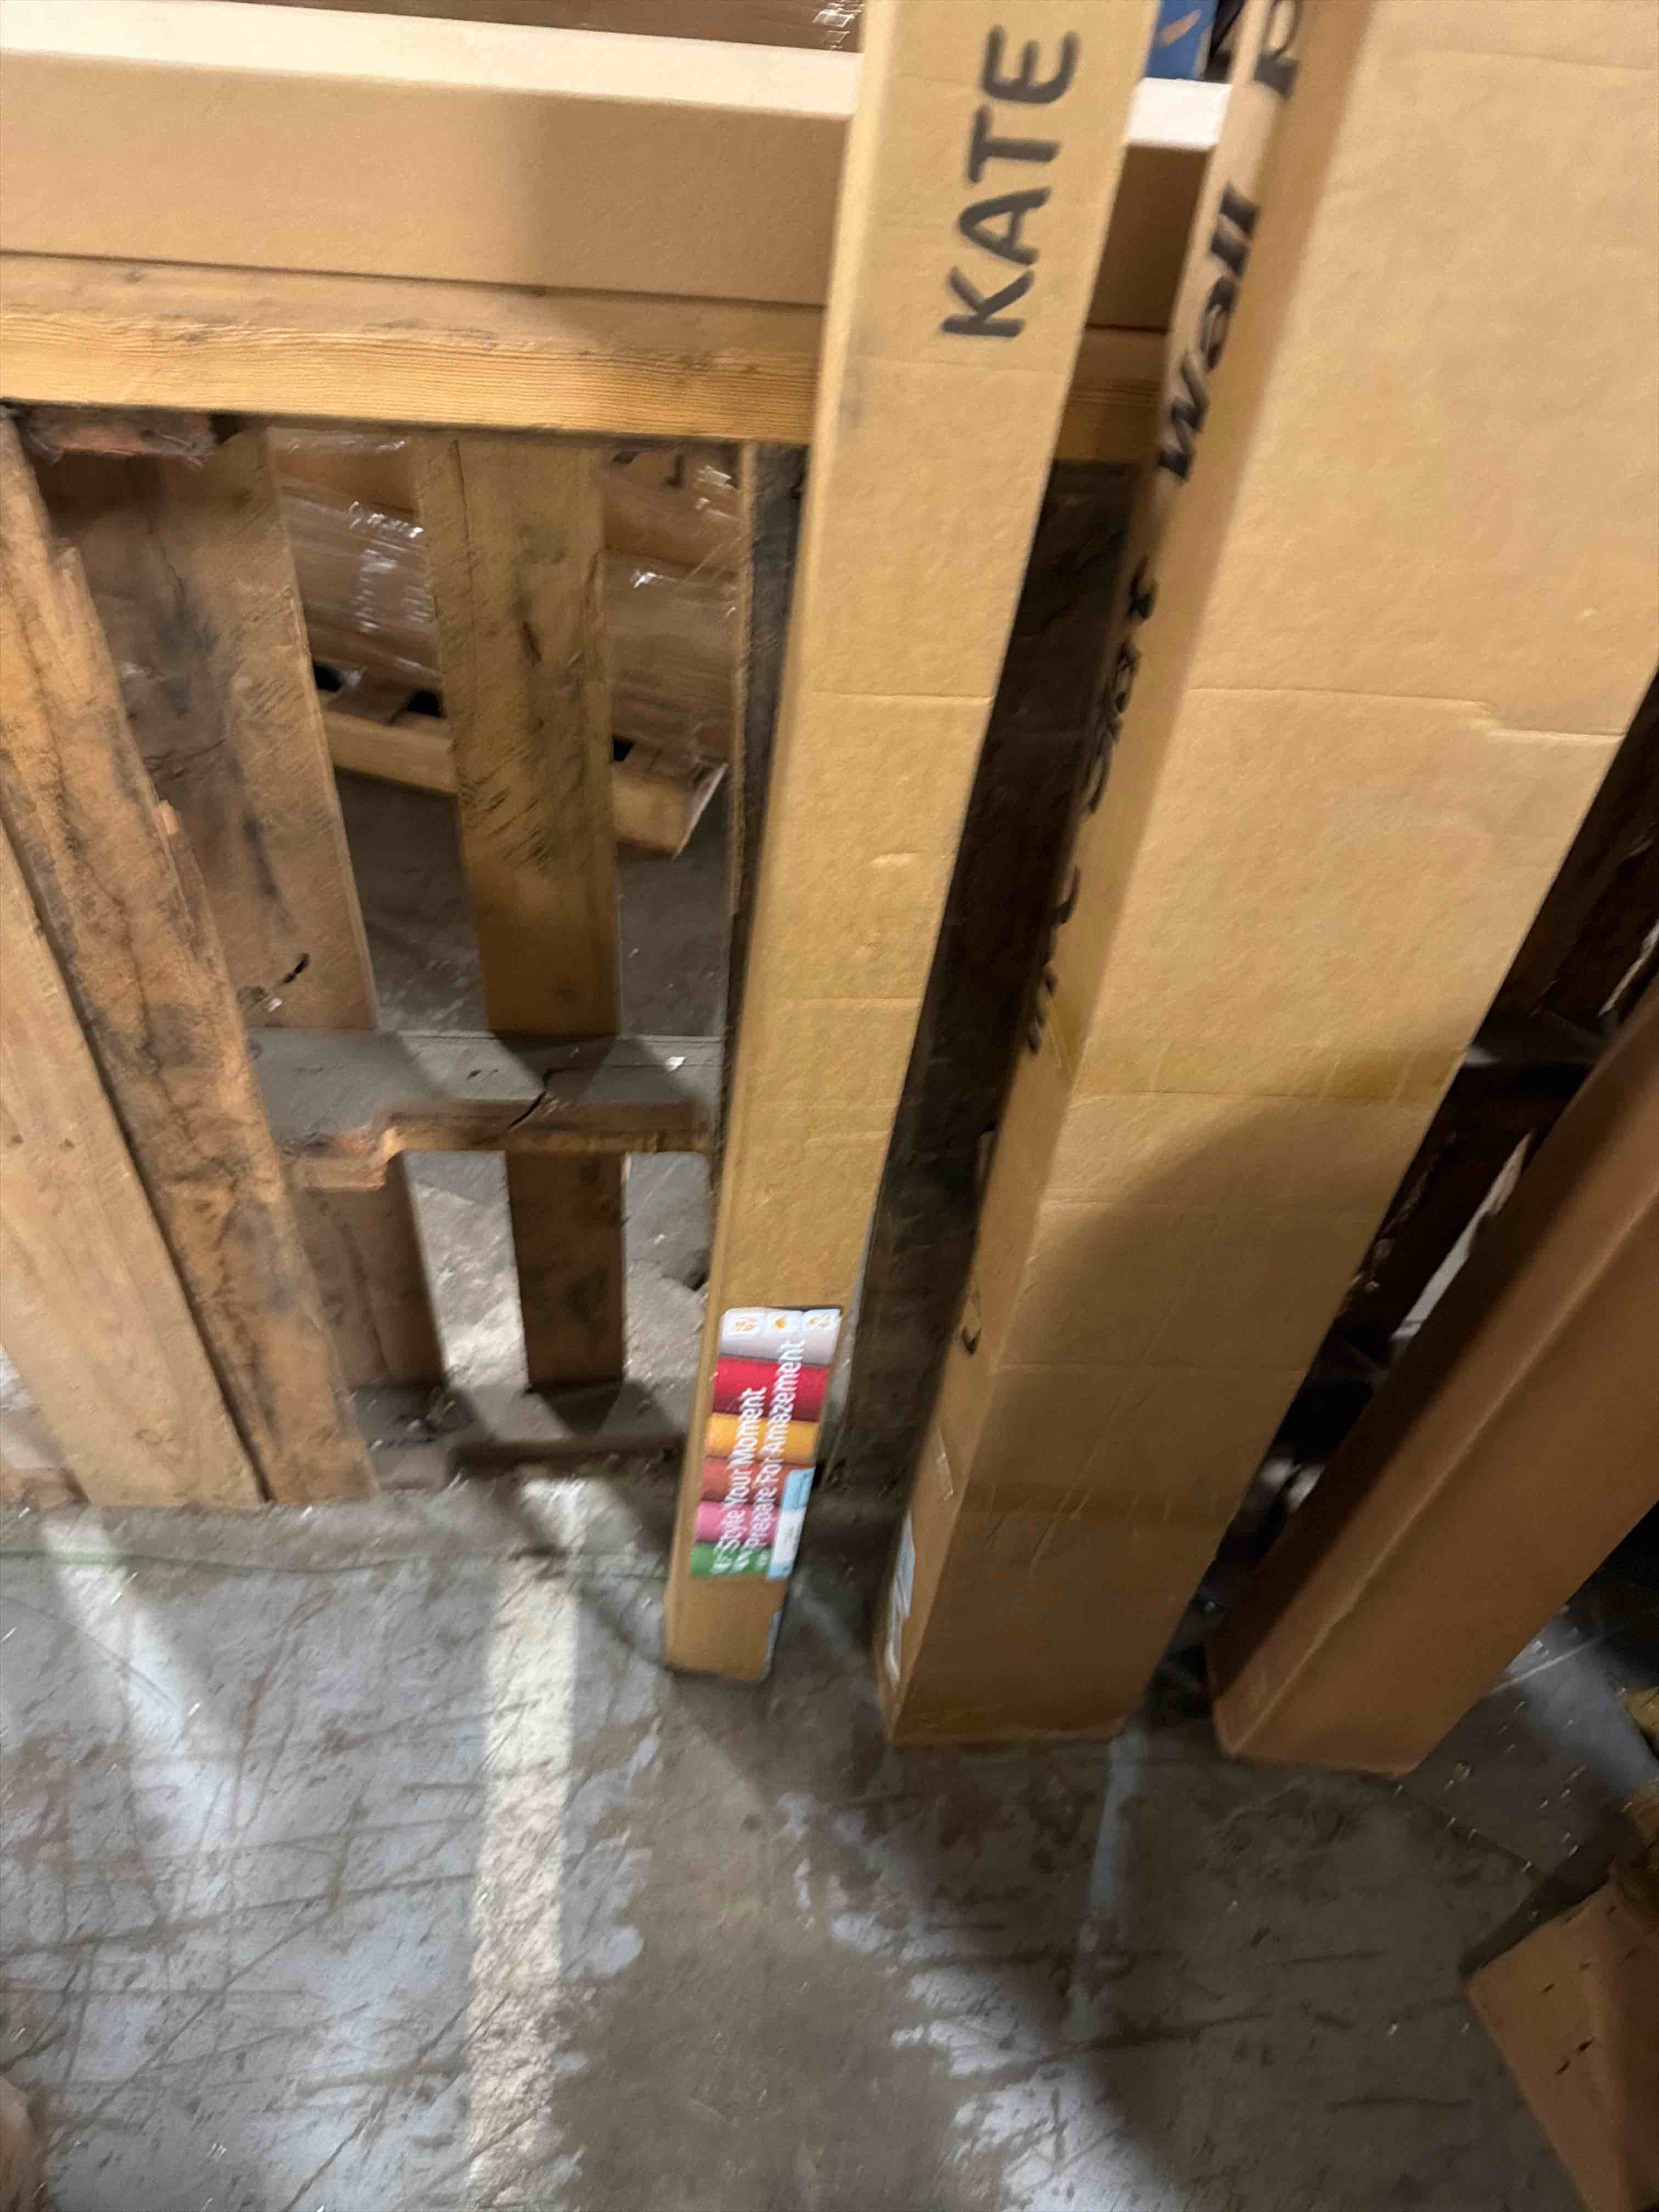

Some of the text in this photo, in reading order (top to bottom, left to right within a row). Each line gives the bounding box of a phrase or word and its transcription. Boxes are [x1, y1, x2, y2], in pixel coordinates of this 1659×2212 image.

[940, 24, 1082, 338] KATE
[727, 1386, 768, 1468] Moment
[760, 1338, 806, 1462] Amazement
[723, 1462, 753, 1513] Your
[752, 1455, 783, 1493] For
[718, 1508, 746, 1555] Style
[744, 1490, 778, 1550] Prepare
